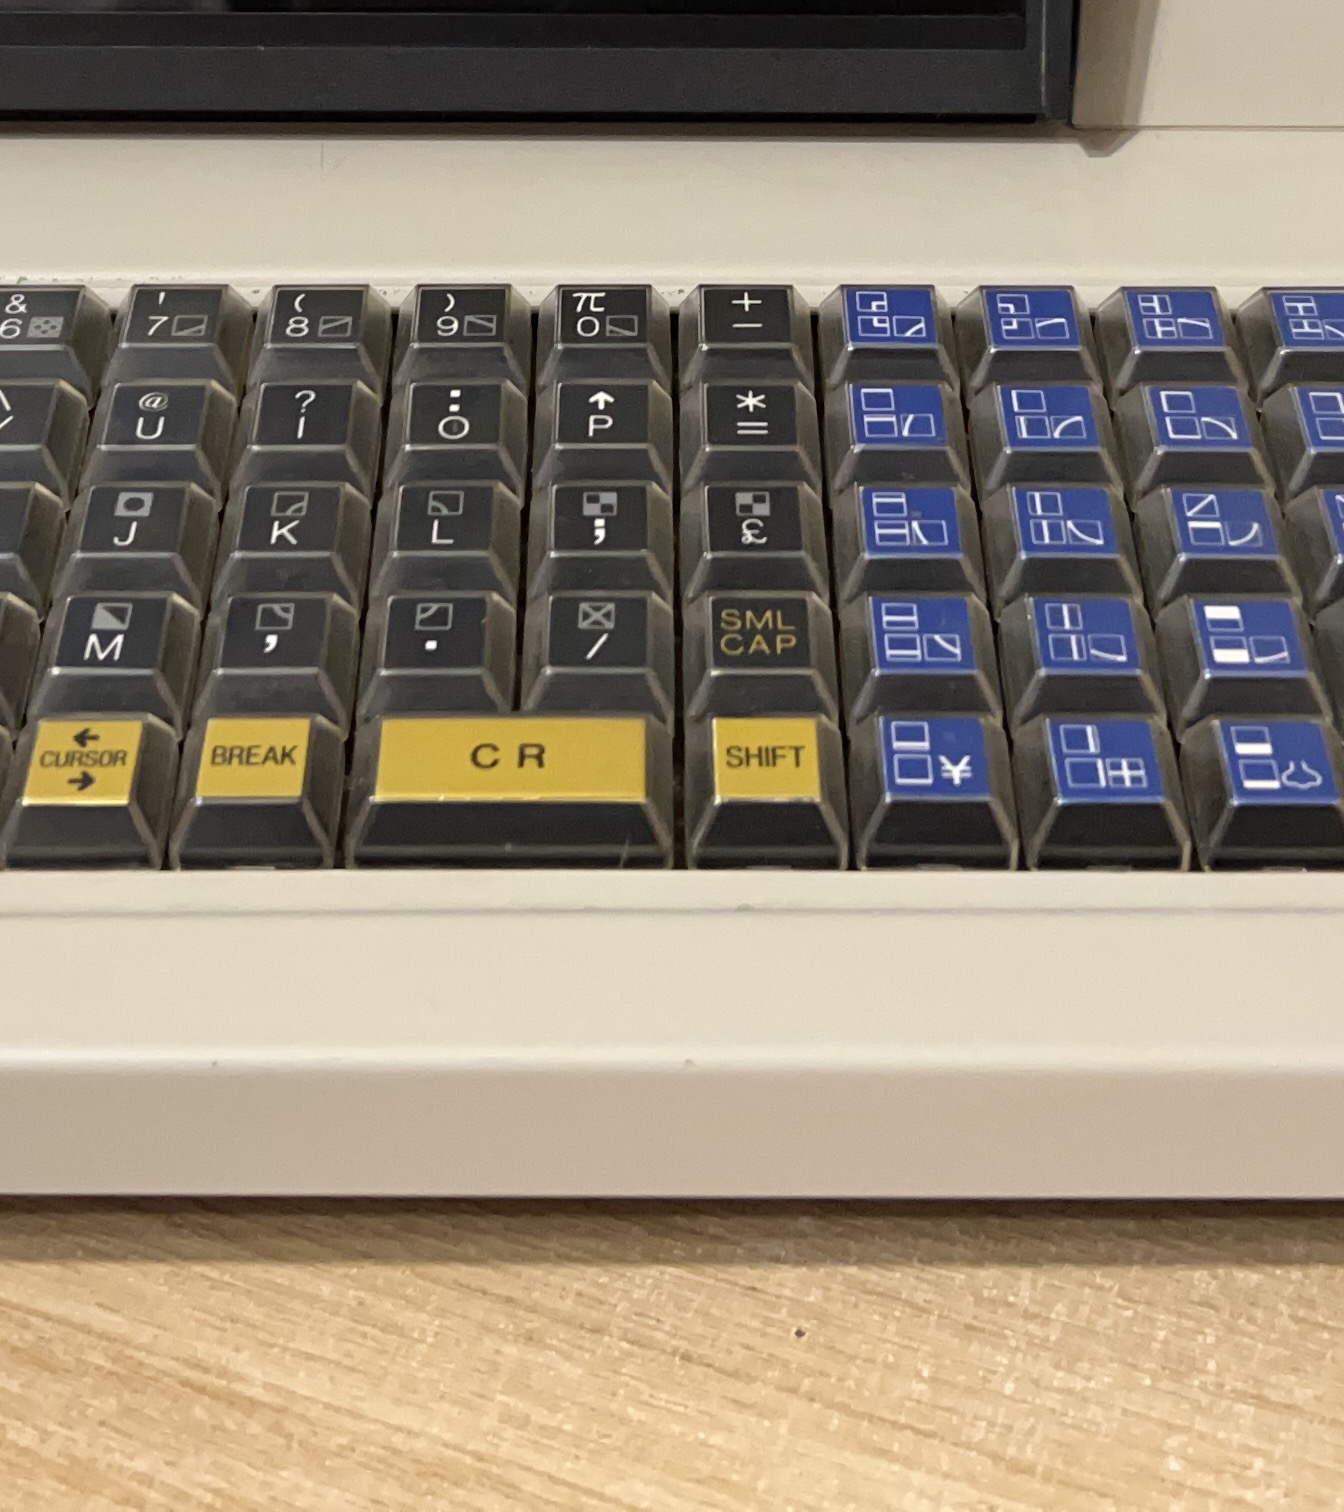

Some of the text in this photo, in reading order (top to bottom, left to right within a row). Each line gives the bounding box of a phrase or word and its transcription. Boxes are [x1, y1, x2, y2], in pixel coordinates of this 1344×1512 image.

[147, 316, 169, 336] 7
[285, 317, 309, 336] 8
[437, 316, 459, 336] 9
[136, 416, 165, 439] U
[588, 415, 614, 437] P
[112, 522, 138, 546] J
[270, 521, 299, 545] K
[432, 520, 454, 544] L
[720, 608, 795, 631] SML
[83, 635, 125, 661] M
[719, 634, 798, 654] CAP
[39, 748, 128, 769] CURSOR
[210, 743, 296, 767] BREAK
[725, 744, 806, 769] SHIFT
